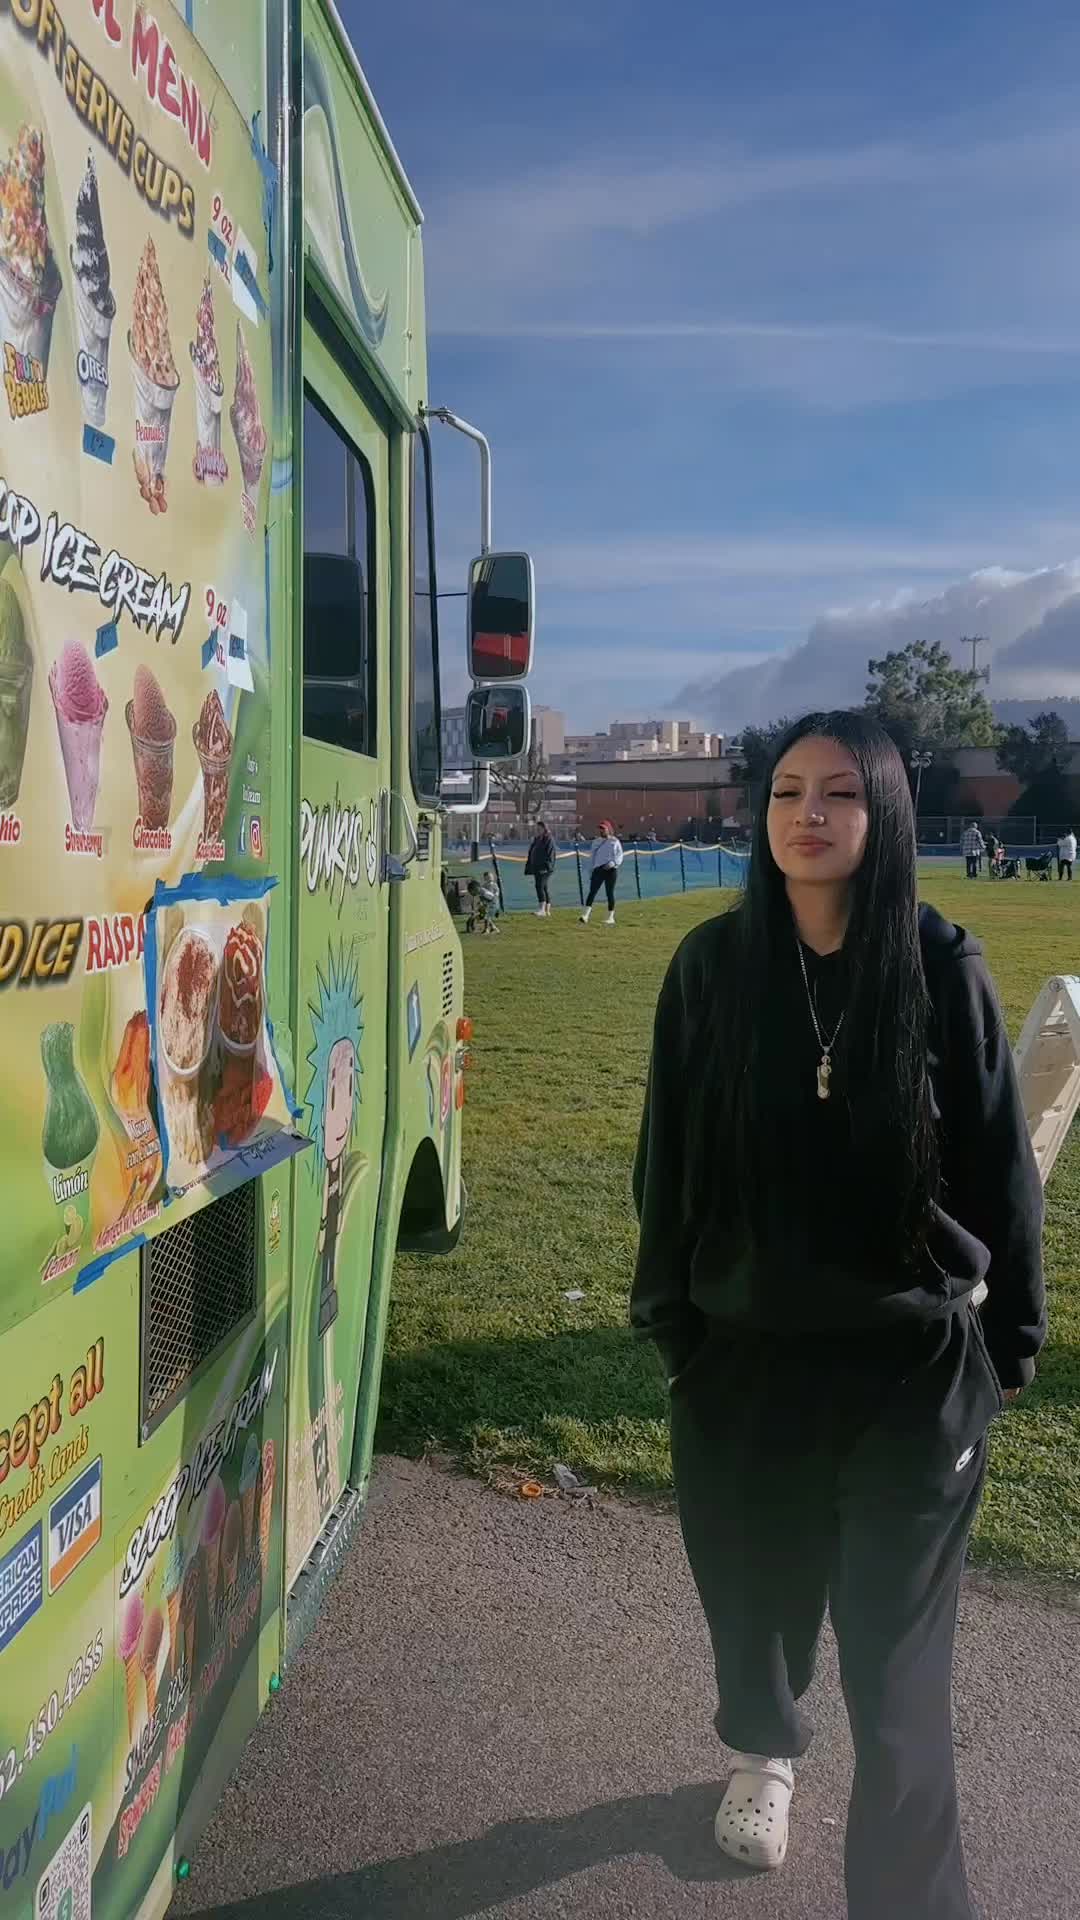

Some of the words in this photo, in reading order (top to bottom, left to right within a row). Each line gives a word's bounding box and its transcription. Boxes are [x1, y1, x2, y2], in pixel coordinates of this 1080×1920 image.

[132, 11, 212, 170] MENU
[65, 43, 135, 168] SERVE
[134, 139, 195, 236] CUPS
[212, 195, 222, 222] 9
[77, 348, 109, 388] OREO
[41, 510, 101, 592] ICE
[100, 549, 191, 645] CREAM
[206, 588, 216, 617] 9
[133, 816, 172, 850] Chocolate
[20, 920, 82, 979] ICE
[69, 1336, 104, 1416] all
[49, 1423, 90, 1488] Cards
[57, 1494, 93, 1554] VISA
